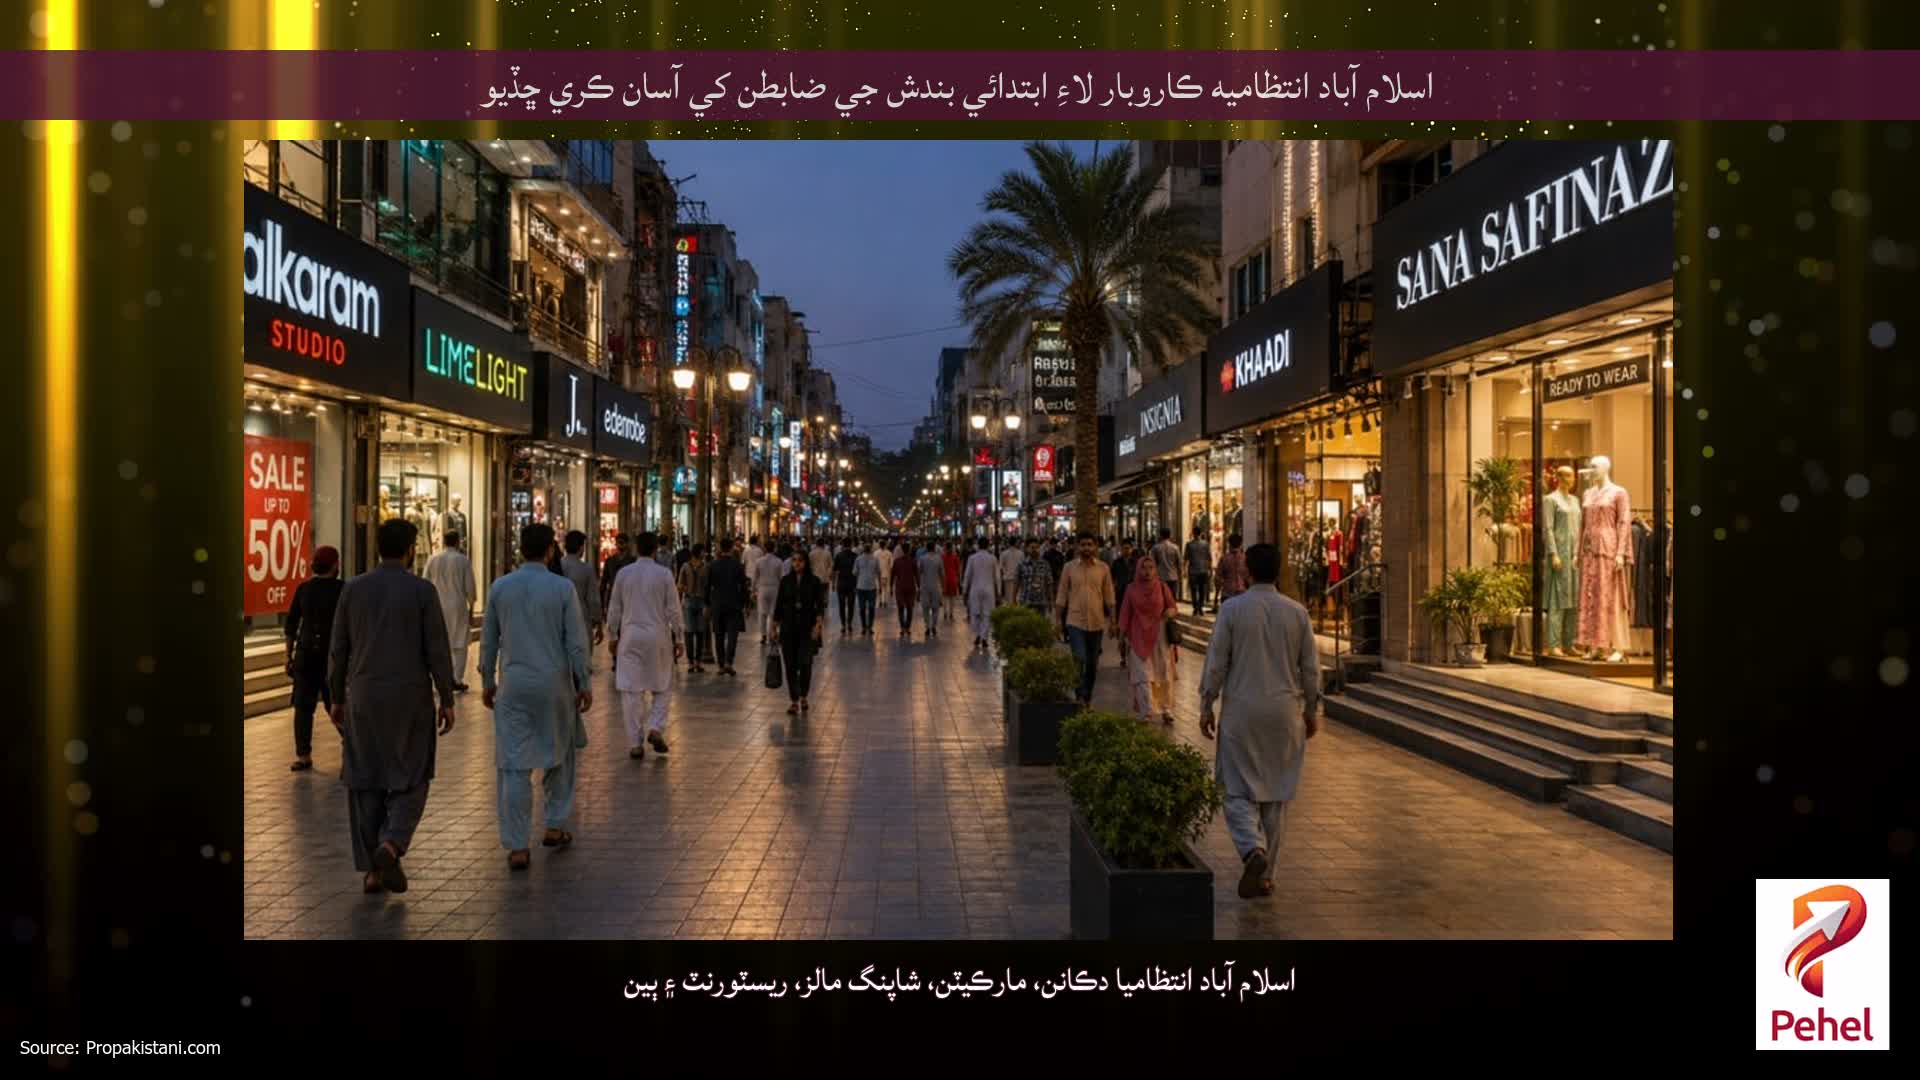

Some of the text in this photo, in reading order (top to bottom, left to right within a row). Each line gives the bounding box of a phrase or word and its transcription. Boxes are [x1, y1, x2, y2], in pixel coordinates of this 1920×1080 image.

[1396, 140, 1673, 311] SANA SAFINAZ
[244, 218, 380, 338] alkaram
[271, 319, 345, 365] STUDIO
[426, 327, 528, 402] LIMELIGHT
[1235, 328, 1290, 389] KHAADI
[1549, 363, 1639, 397] READY TO WEAR
[604, 401, 646, 444] edenrobe
[1140, 393, 1182, 438] INSIGNIA
[249, 450, 305, 492] SALE
[264, 497, 291, 514] UP TO
[247, 518, 307, 583] 50%
[266, 586, 287, 605] OFF
